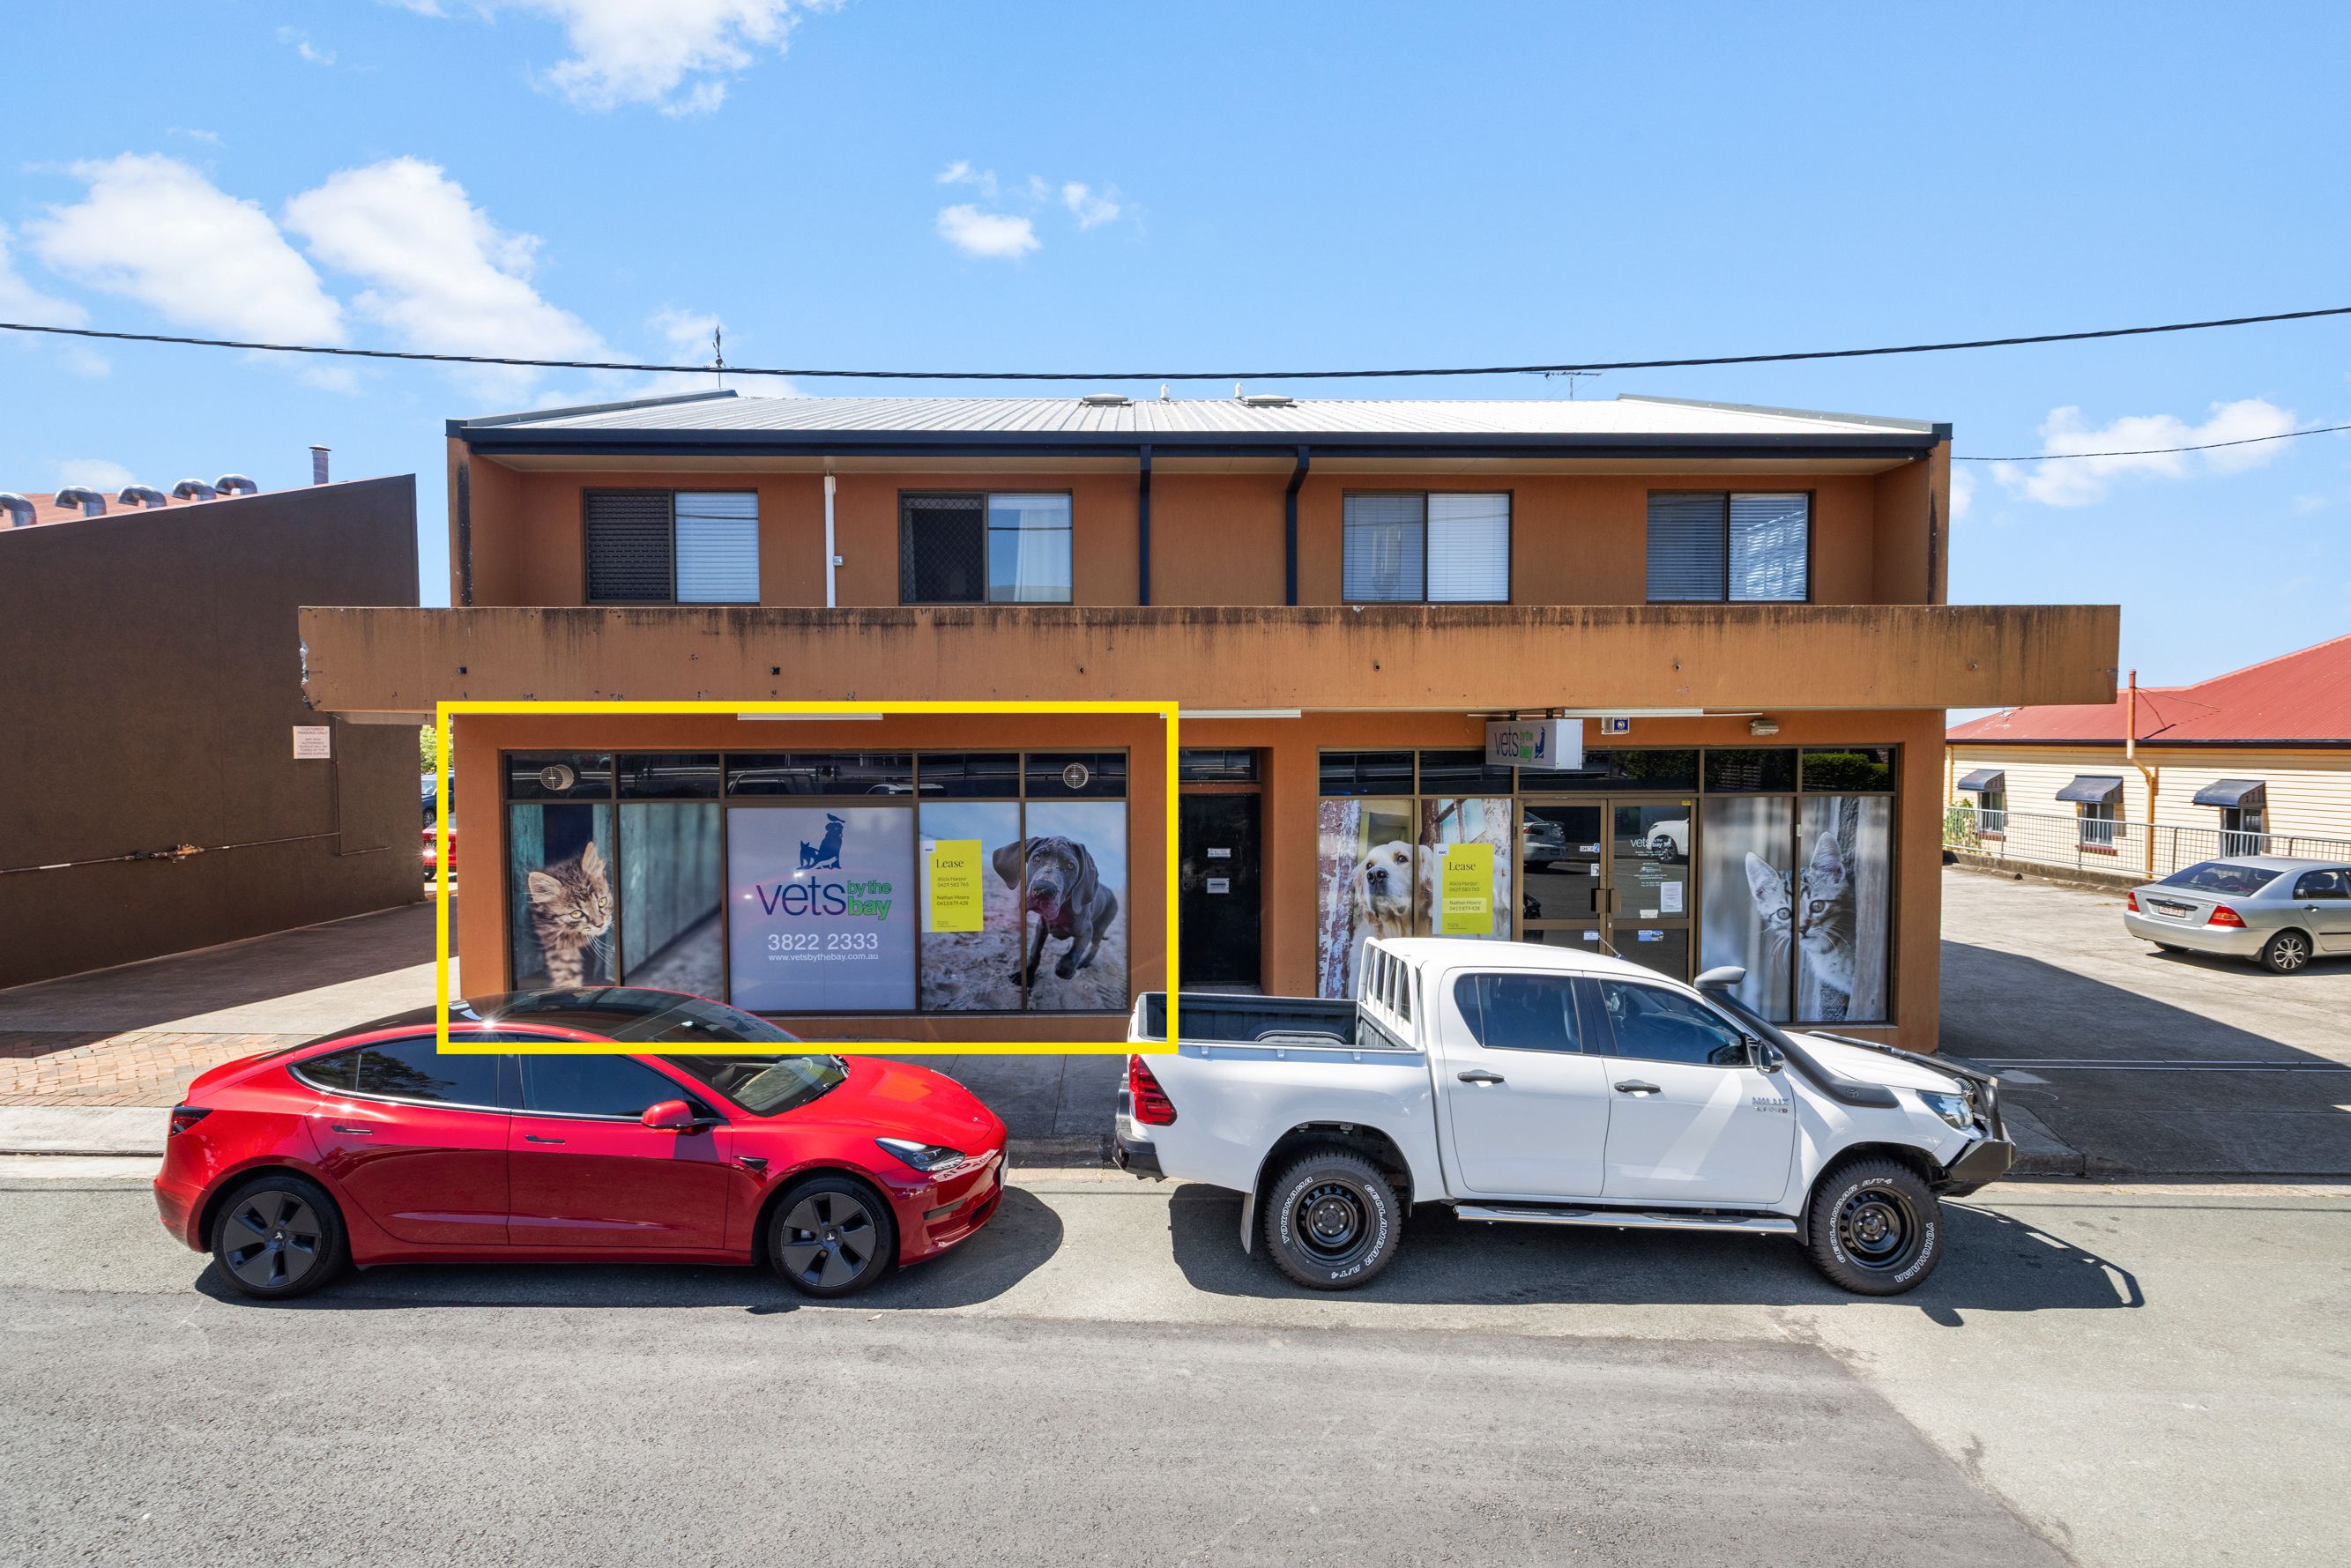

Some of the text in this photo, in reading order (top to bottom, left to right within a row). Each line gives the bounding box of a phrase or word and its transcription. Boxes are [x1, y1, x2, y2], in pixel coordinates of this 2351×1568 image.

[1494, 726, 1519, 757] vets
[1520, 743, 1533, 762] bay
[1595, 843, 1599, 852] 2
[1630, 837, 1652, 848] vets
[936, 859, 964, 868] Lease
[1448, 862, 1477, 871] Lease
[755, 876, 892, 916] vets by the
[847, 895, 892, 921] bay
[768, 933, 878, 951] 3822 2333
[768, 953, 879, 962] www.vetsbythebay.com.au
[1280, 1177, 1313, 1244] YOKOHAMA
[1829, 1178, 1893, 1263] GEOLANDAR A/T4
[1331, 1185, 1388, 1279] GEOLANDAR A/T4
[1894, 1222, 1935, 1282] YOKOHAMA
